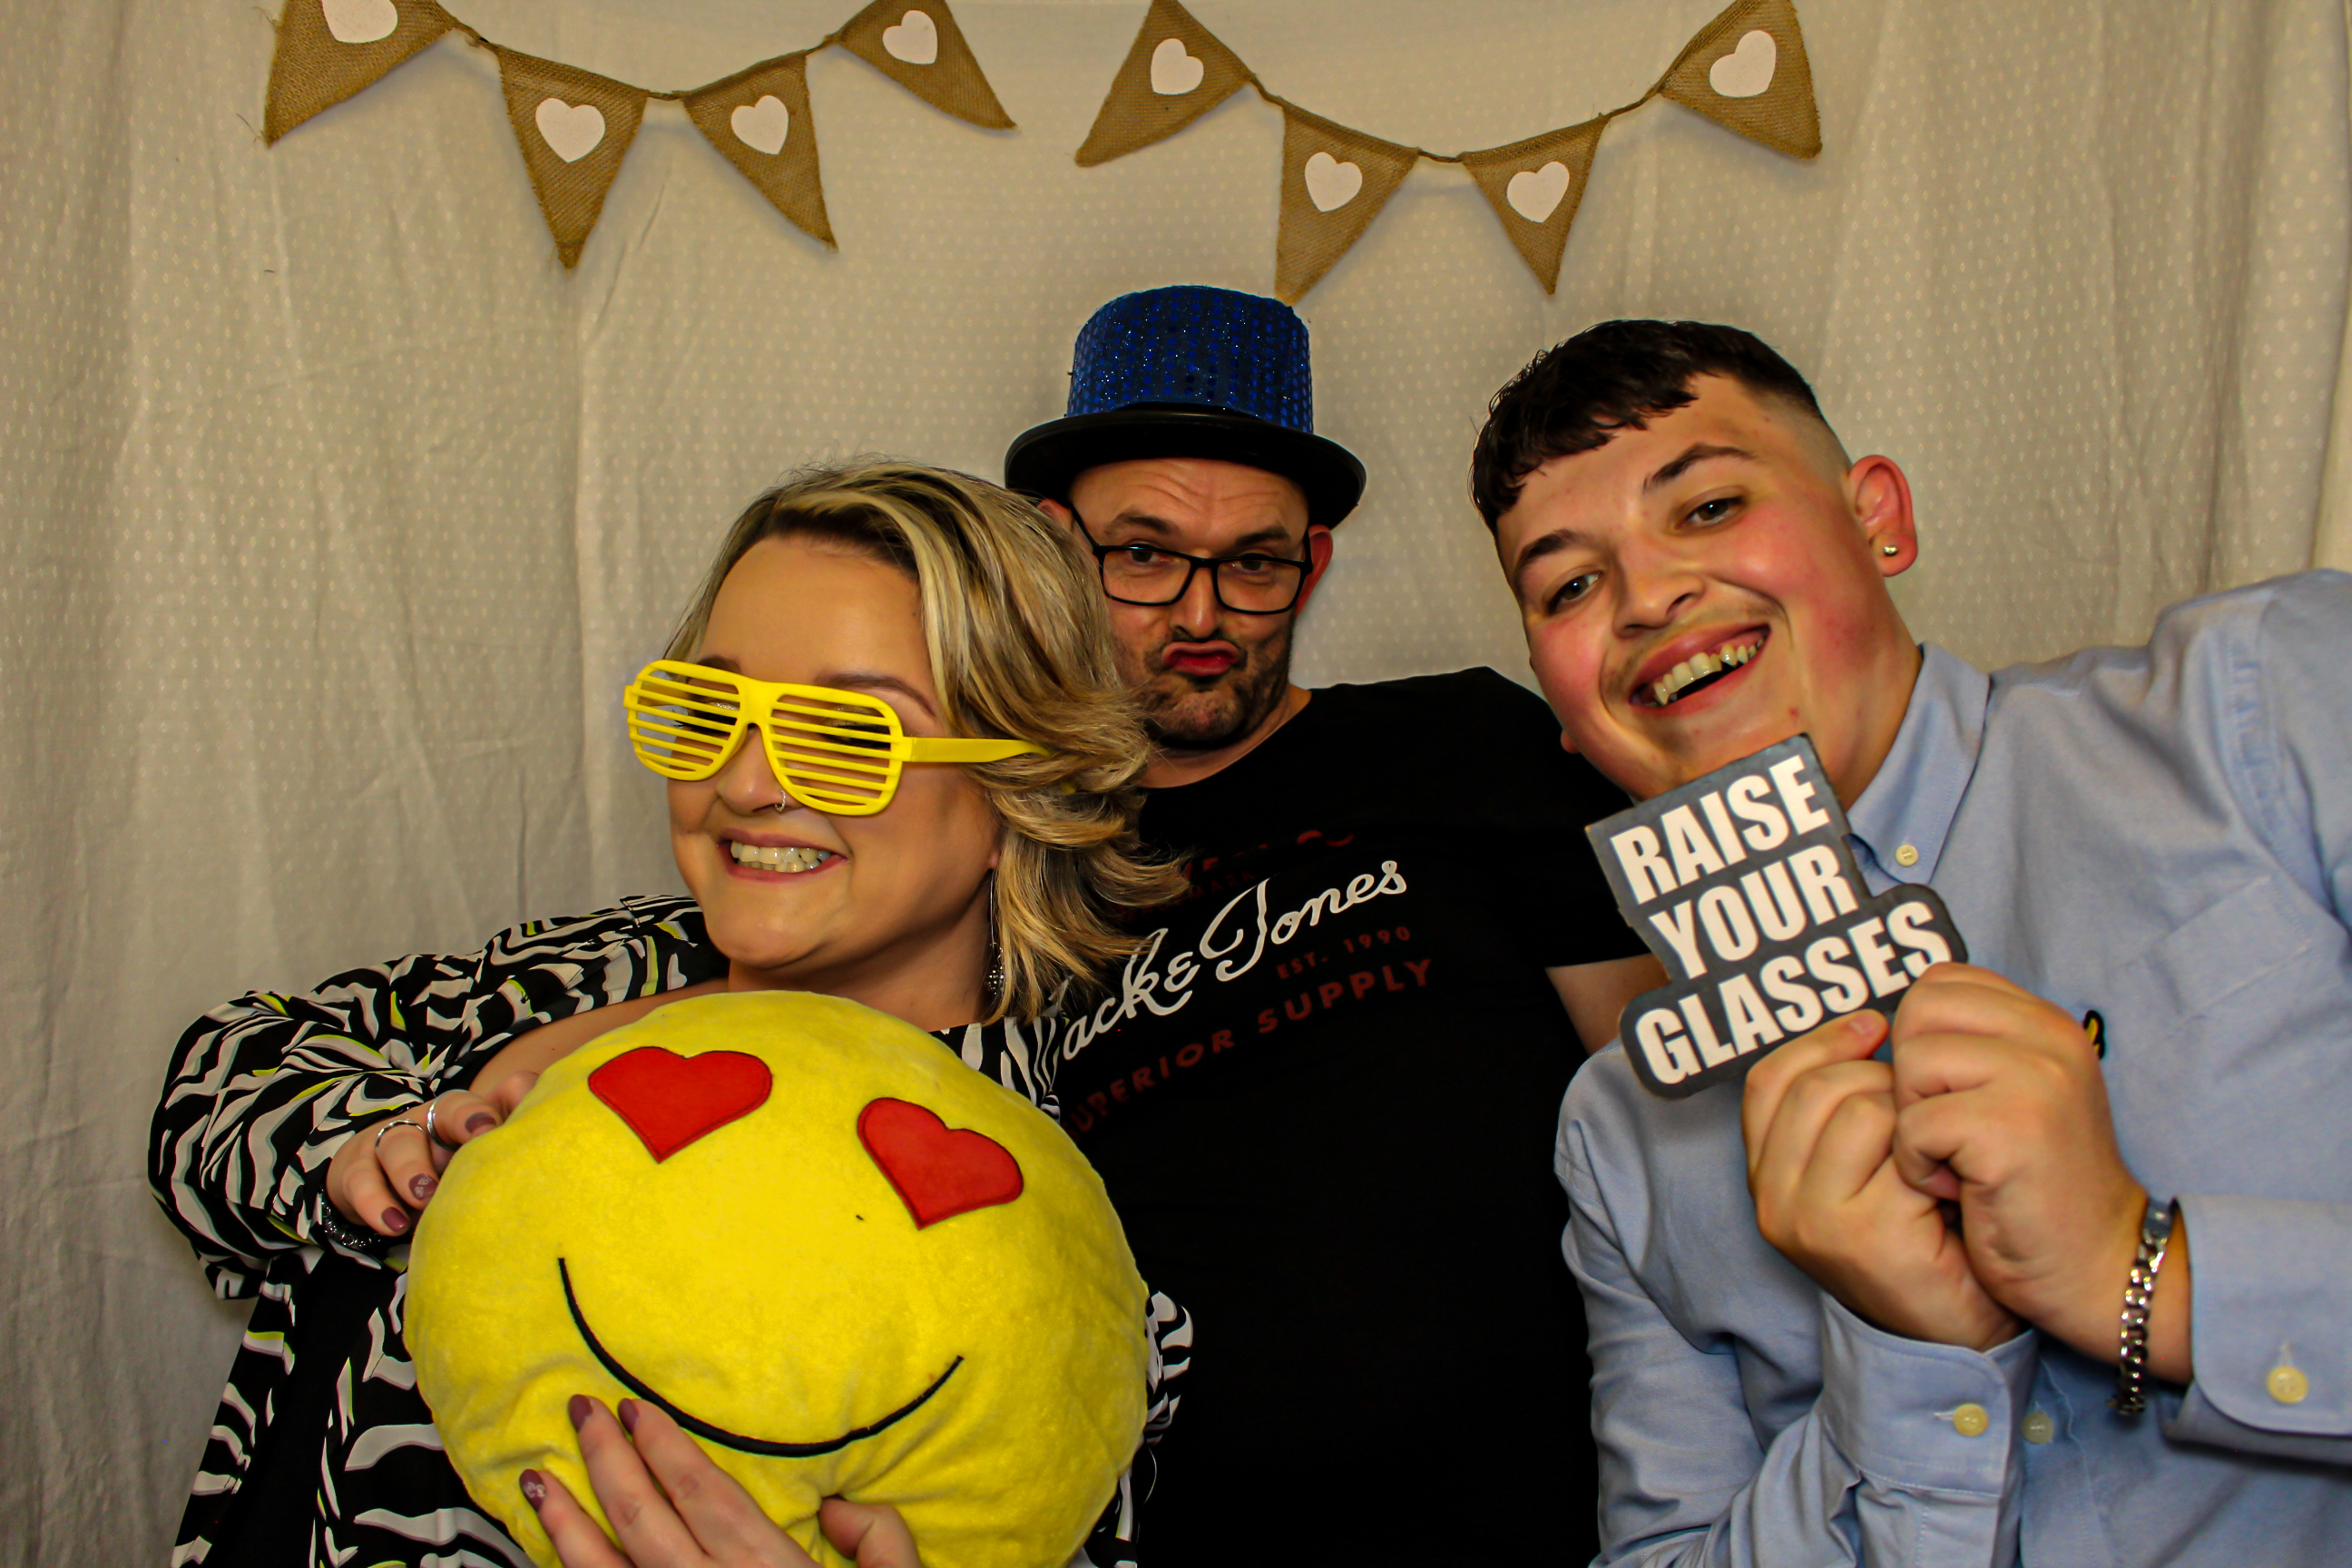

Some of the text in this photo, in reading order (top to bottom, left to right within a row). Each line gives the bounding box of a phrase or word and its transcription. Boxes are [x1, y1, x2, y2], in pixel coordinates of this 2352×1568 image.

[1610, 754, 1830, 905] RAISE
[1063, 927, 1193, 1060] ack
[1199, 859, 1407, 982] Jones
[1275, 926, 1412, 981] EST. 1990
[1648, 844, 1859, 980] YOUR
[1257, 957, 1433, 1034] SUPPLY
[1635, 901, 1952, 1084] GLASSES
